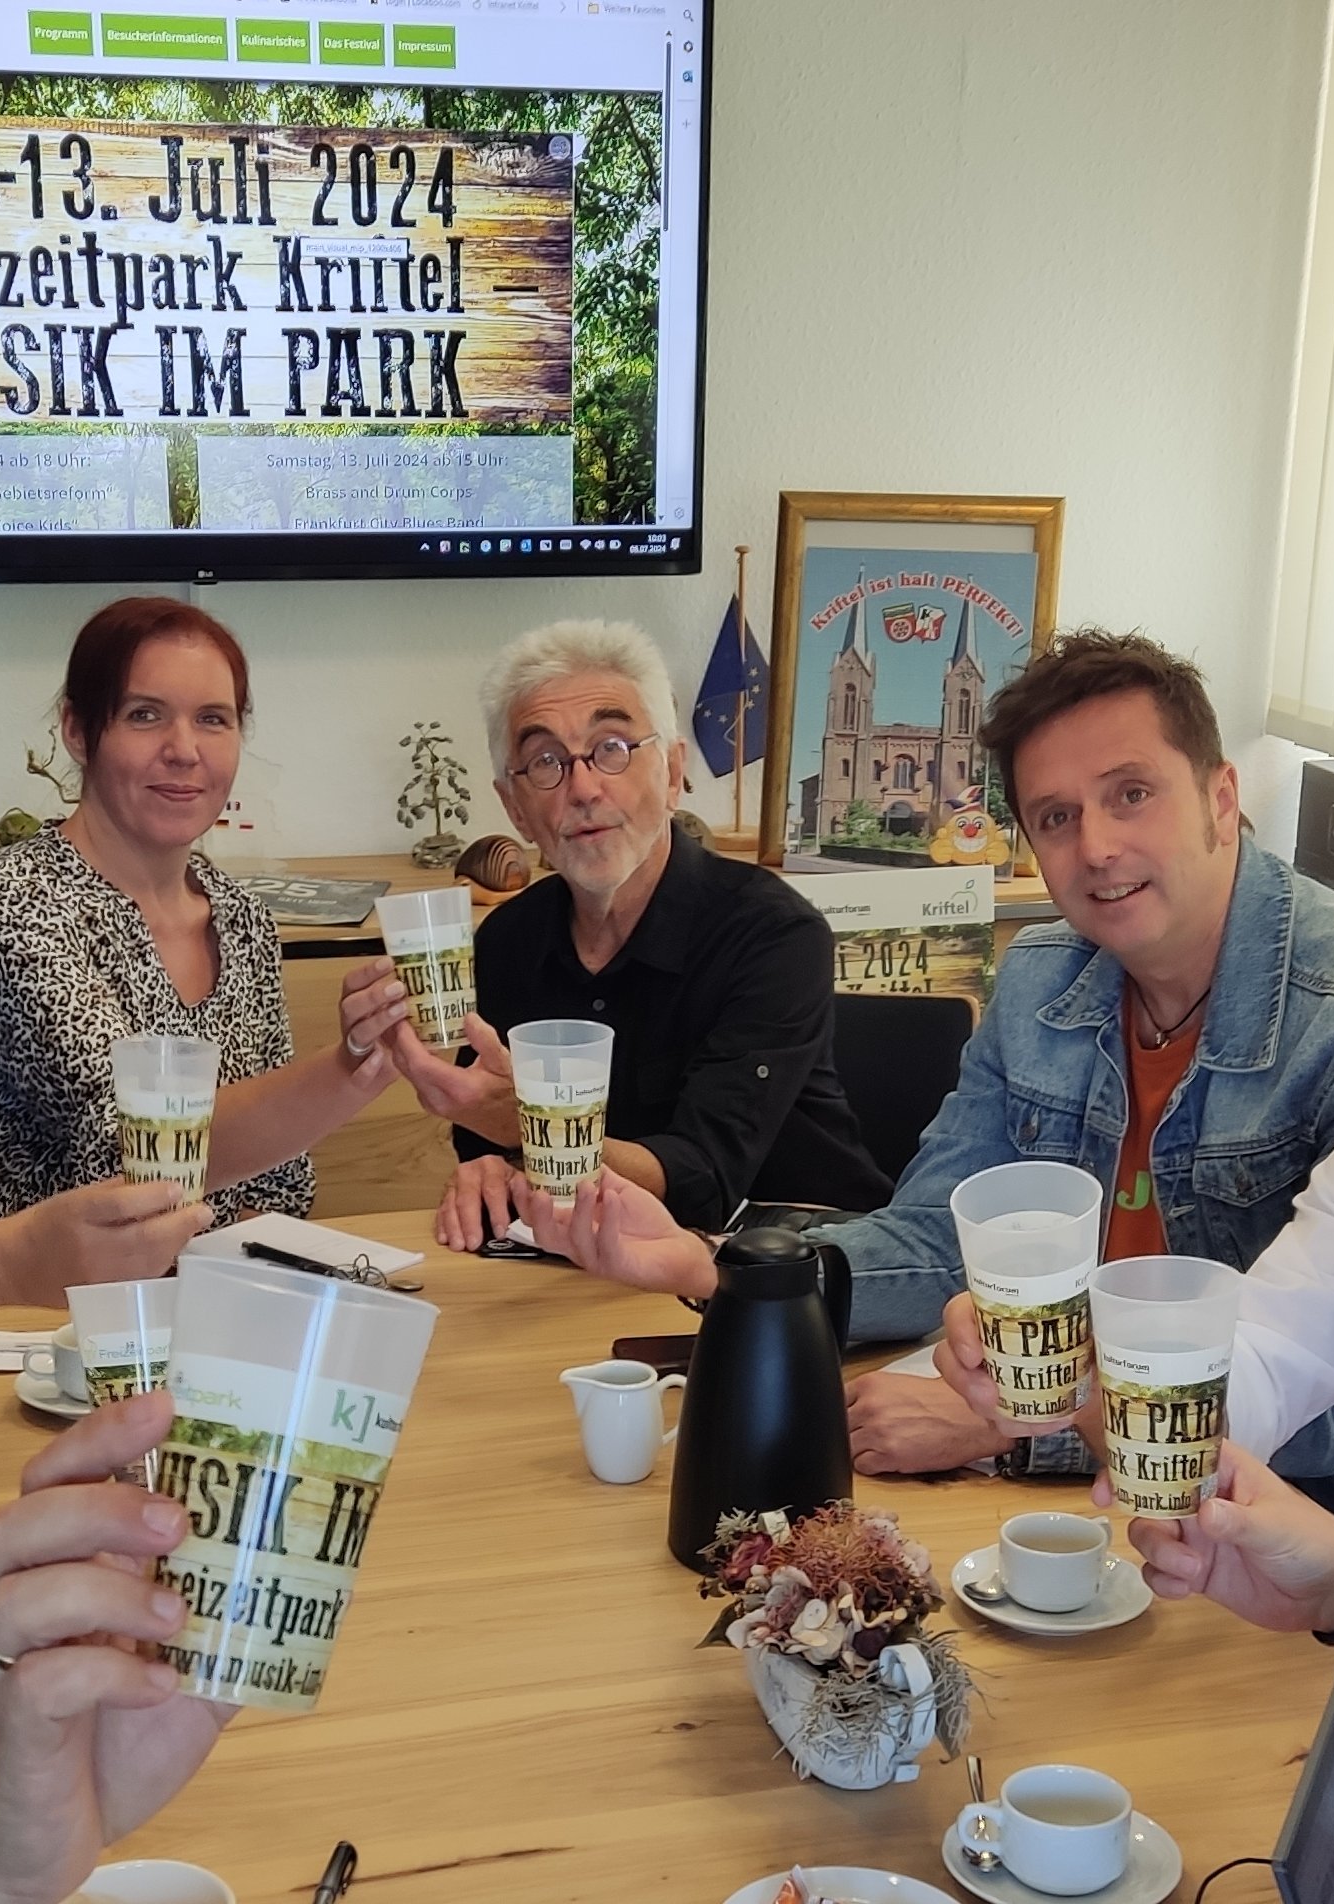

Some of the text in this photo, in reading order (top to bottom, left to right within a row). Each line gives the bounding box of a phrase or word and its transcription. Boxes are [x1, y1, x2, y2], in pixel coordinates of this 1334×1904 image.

[34, 27, 88, 40] Programm
[107, 29, 223, 44] Besucherinformationen
[241, 35, 307, 48] Kulinarisches
[324, 38, 380, 50] Das Festival
[398, 40, 452, 54] Impressum
[148, 135, 277, 226] Juli
[309, 142, 457, 228] 2024
[156, 324, 251, 417] IM
[281, 326, 469, 418] PARK
[9, 452, 28, 467] ab
[34, 453, 53, 467] 18
[58, 453, 91, 468] Uhr:
[267, 453, 509, 471] Samstag, 13. Juli 2024 ab 15 Uhr:
[305, 485, 473, 501] Brass and Drum Corps
[447, 515, 485, 528] Band
[810, 571, 1026, 639] Kriftel ist halt PERFEKT!
[922, 899, 970, 917] Kriftel
[863, 939, 929, 979] 2024
[564, 1115, 595, 1148] IM
[120, 1128, 204, 1162] SIK IM
[1010, 1356, 1078, 1391] Kriftel
[1135, 1450, 1205, 1482] Kriftel
[316, 1481, 381, 1568] IM
